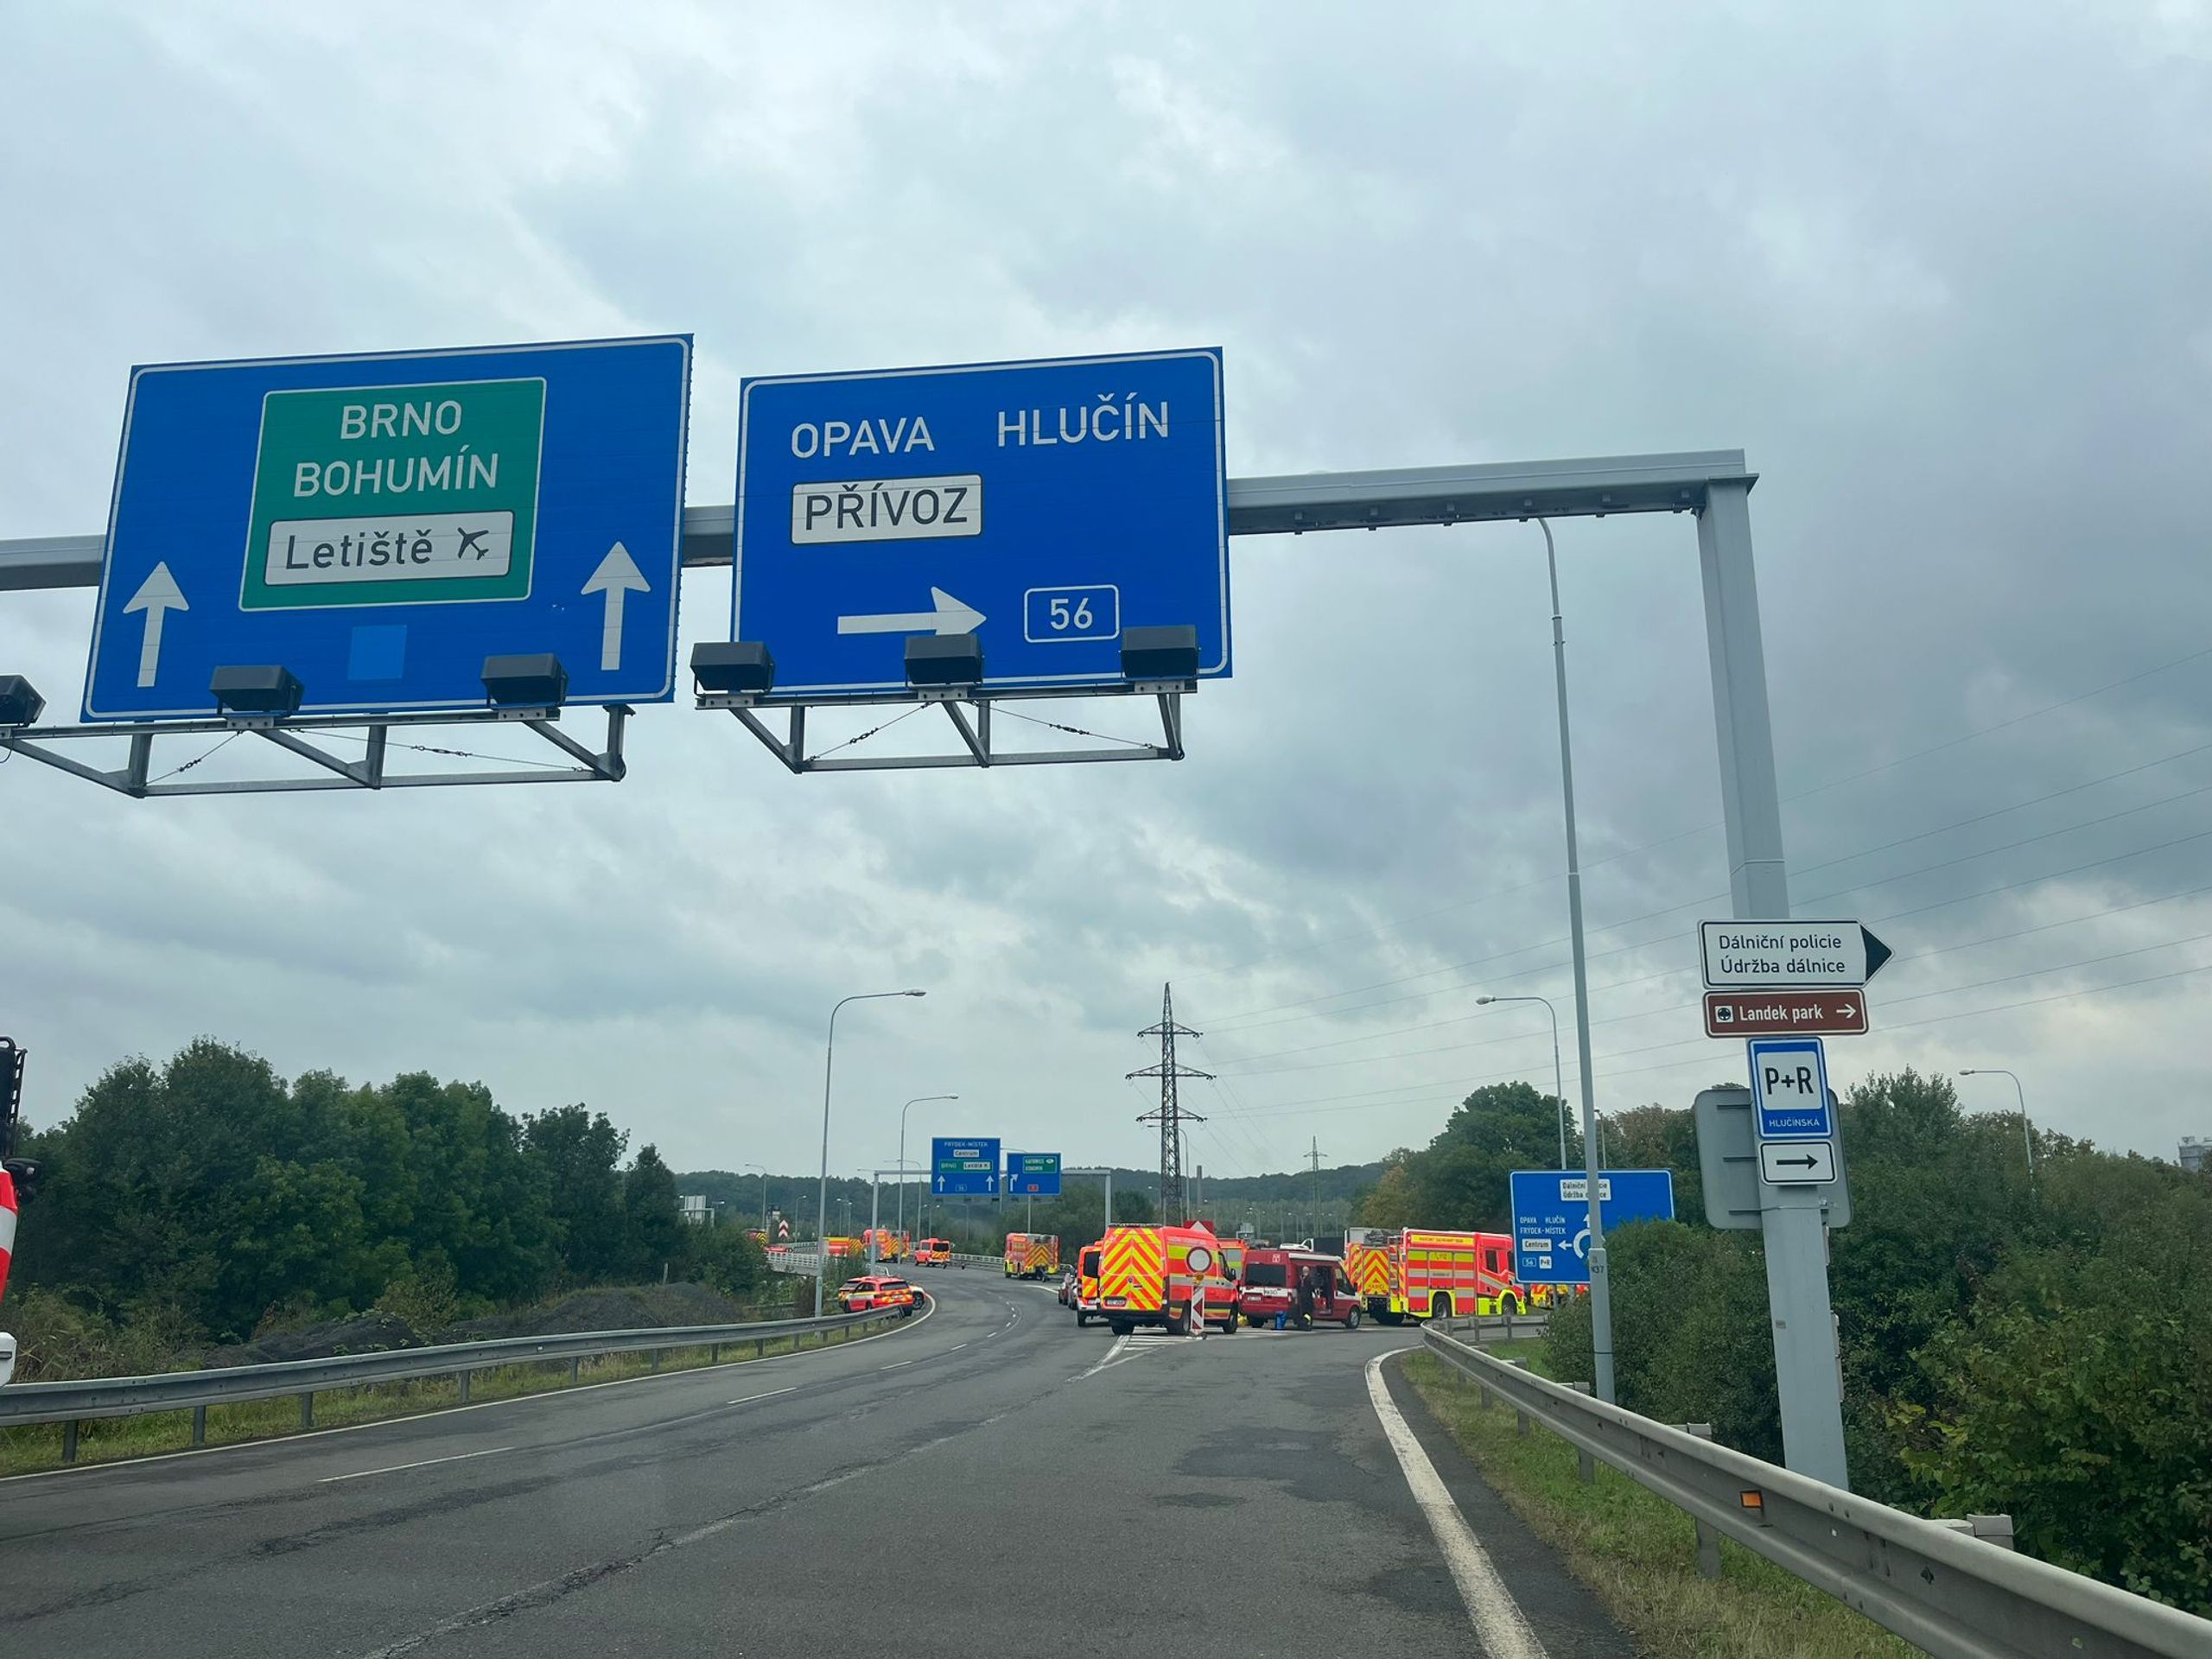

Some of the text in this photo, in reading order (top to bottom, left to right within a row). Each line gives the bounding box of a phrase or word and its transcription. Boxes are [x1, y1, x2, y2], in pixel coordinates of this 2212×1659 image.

[340, 400, 462, 440] BRNO
[791, 392, 1169, 459] OPAVA HLUČÍN
[294, 444, 499, 498] BOHUMÍN
[805, 482, 968, 531] PŘÍVOZ
[285, 529, 432, 570] Letiště
[1050, 598, 1093, 630] 56
[1719, 934, 1841, 952] Dálniční policie
[1721, 955, 1846, 974] Údržba dálnice
[1739, 1003, 1824, 1023] Landek park
[1765, 1066, 1814, 1095] P+R
[1769, 1116, 1820, 1128] HLUČÍNSKÁ
